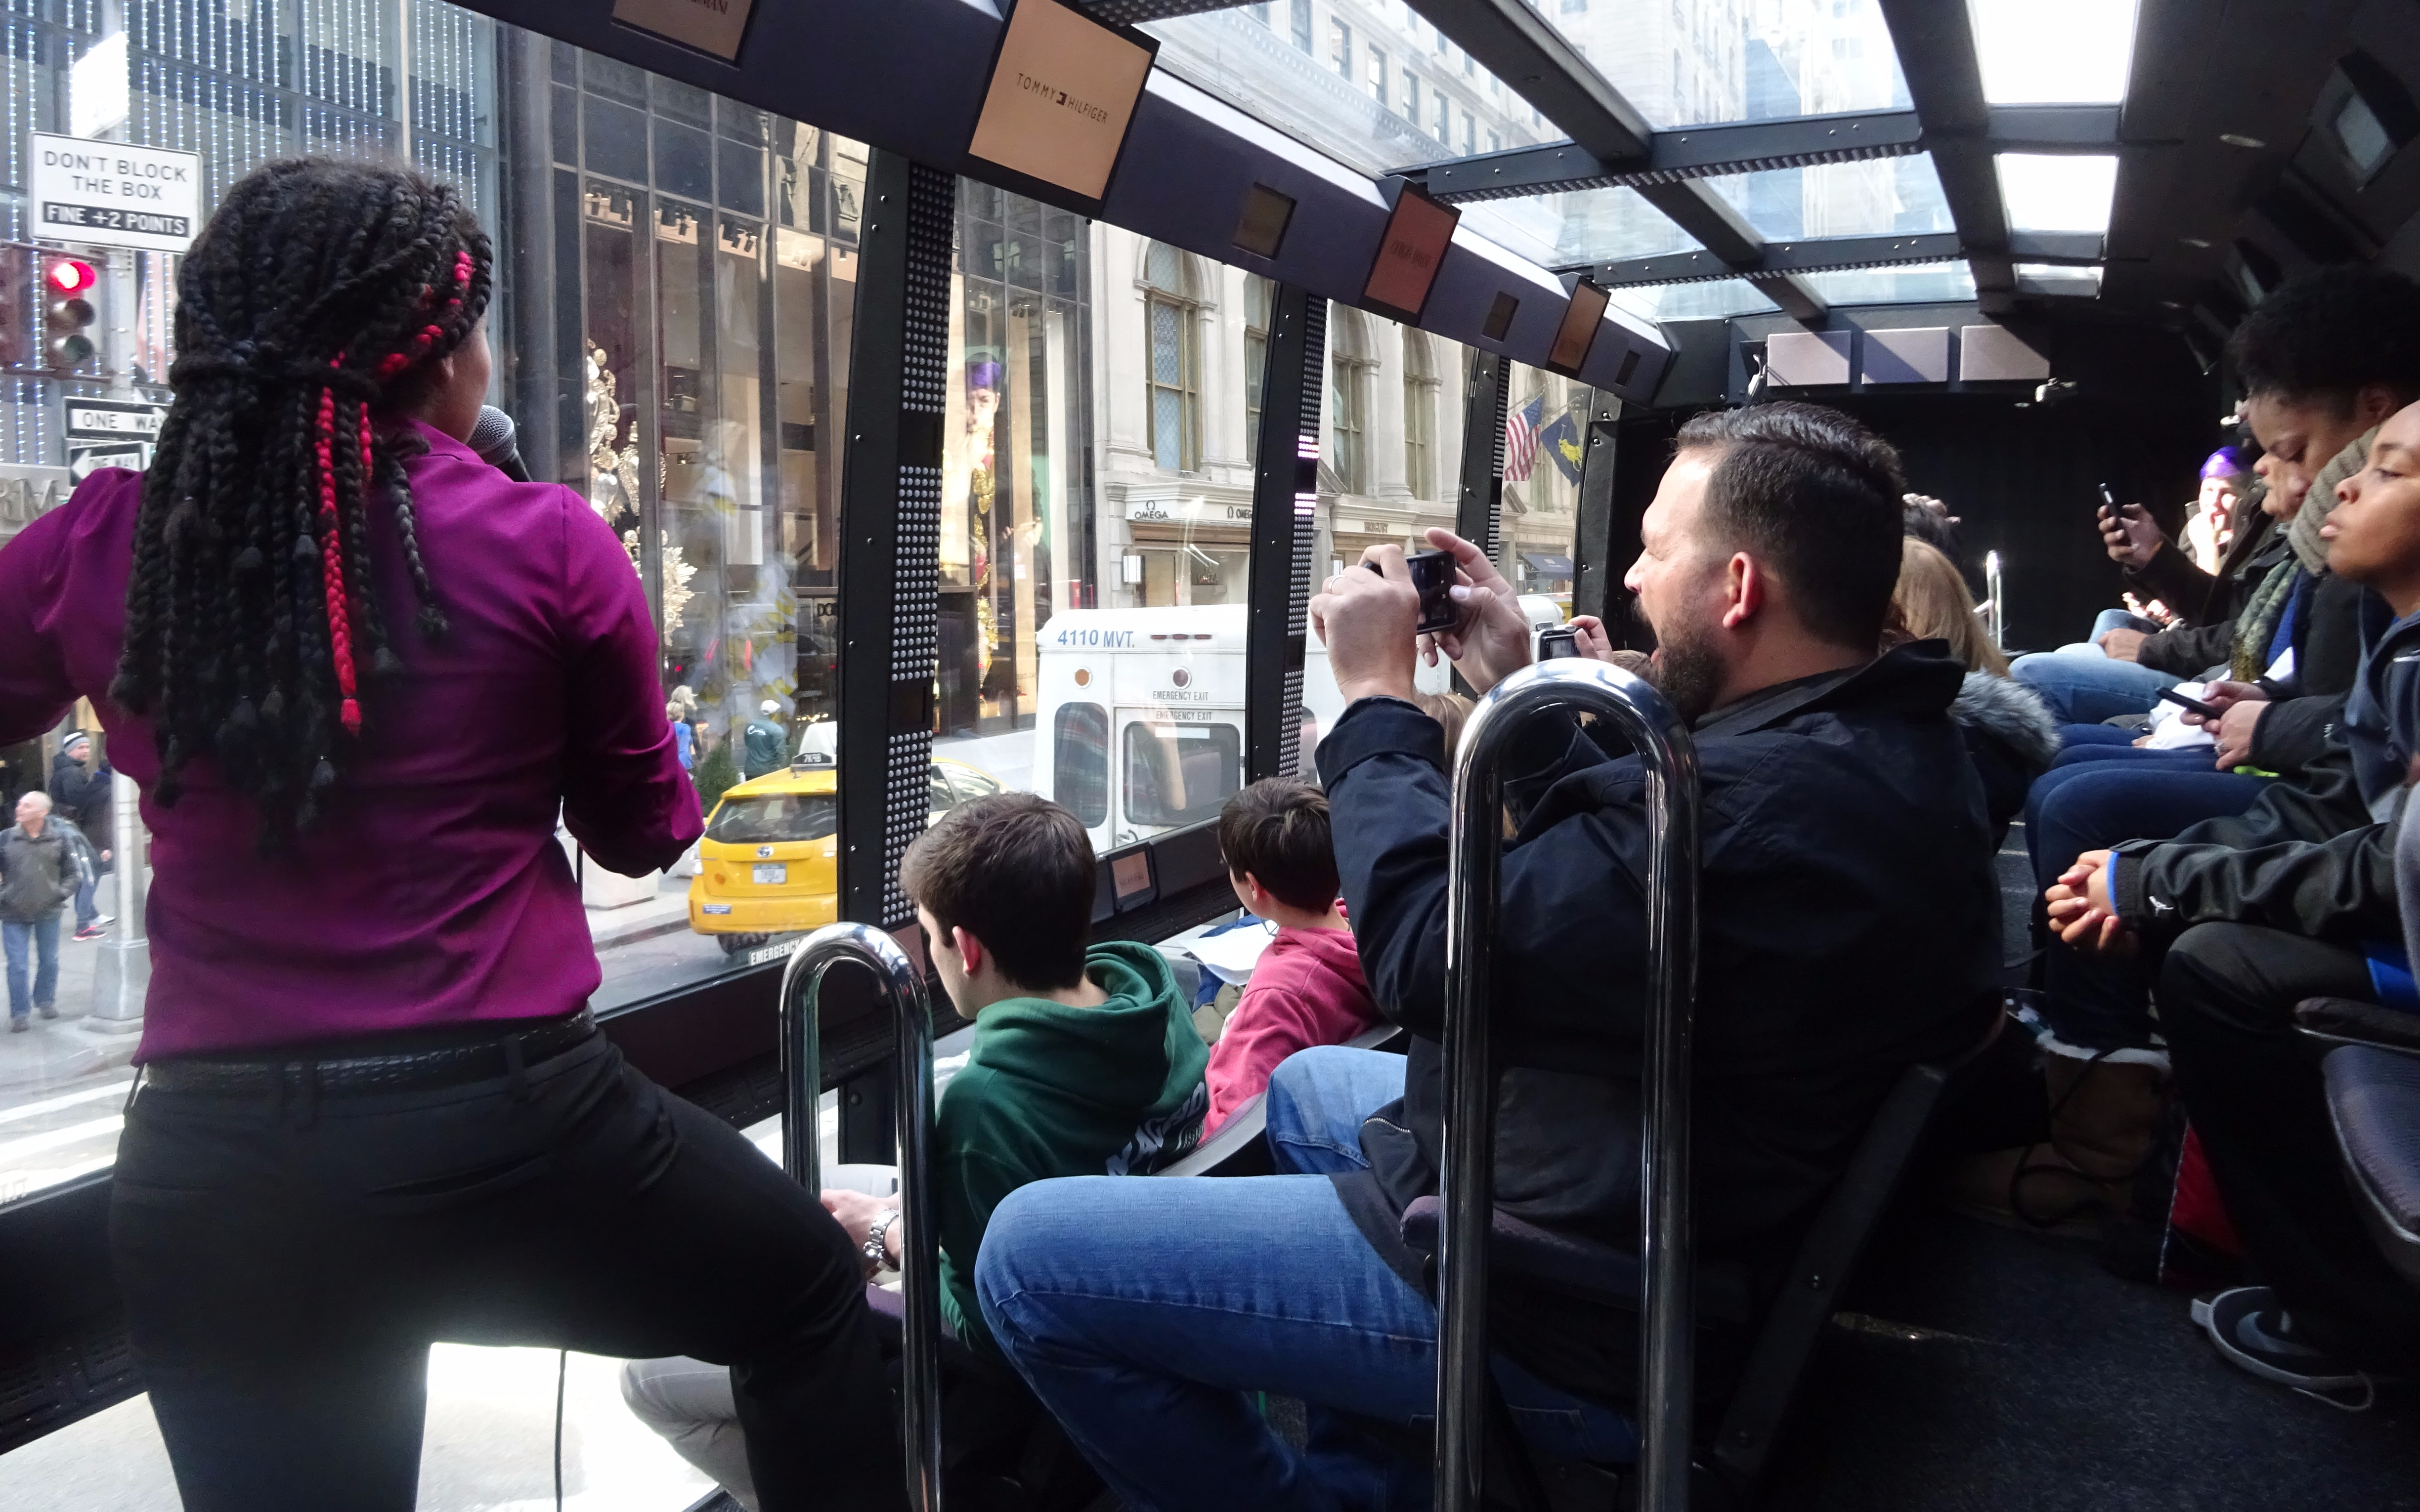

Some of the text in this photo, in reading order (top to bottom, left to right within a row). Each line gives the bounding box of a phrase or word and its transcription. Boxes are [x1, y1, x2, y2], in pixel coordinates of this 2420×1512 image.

[1017, 73, 1108, 124] TOMMY HILFIGER
[44, 151, 187, 182] DON'T BLOCK
[72, 175, 163, 200] THE BOX
[47, 204, 186, 235] FINE +2 POINTS
[83, 412, 119, 429] ONE
[1134, 510, 1168, 519] OMEGA
[1057, 630, 1134, 648] 4110 MVT.
[1153, 691, 1209, 701] EMERGENCY EXIT
[1156, 711, 1212, 721] EMERGENCY EXIT
[750, 939, 800, 966] EMERGENCY
